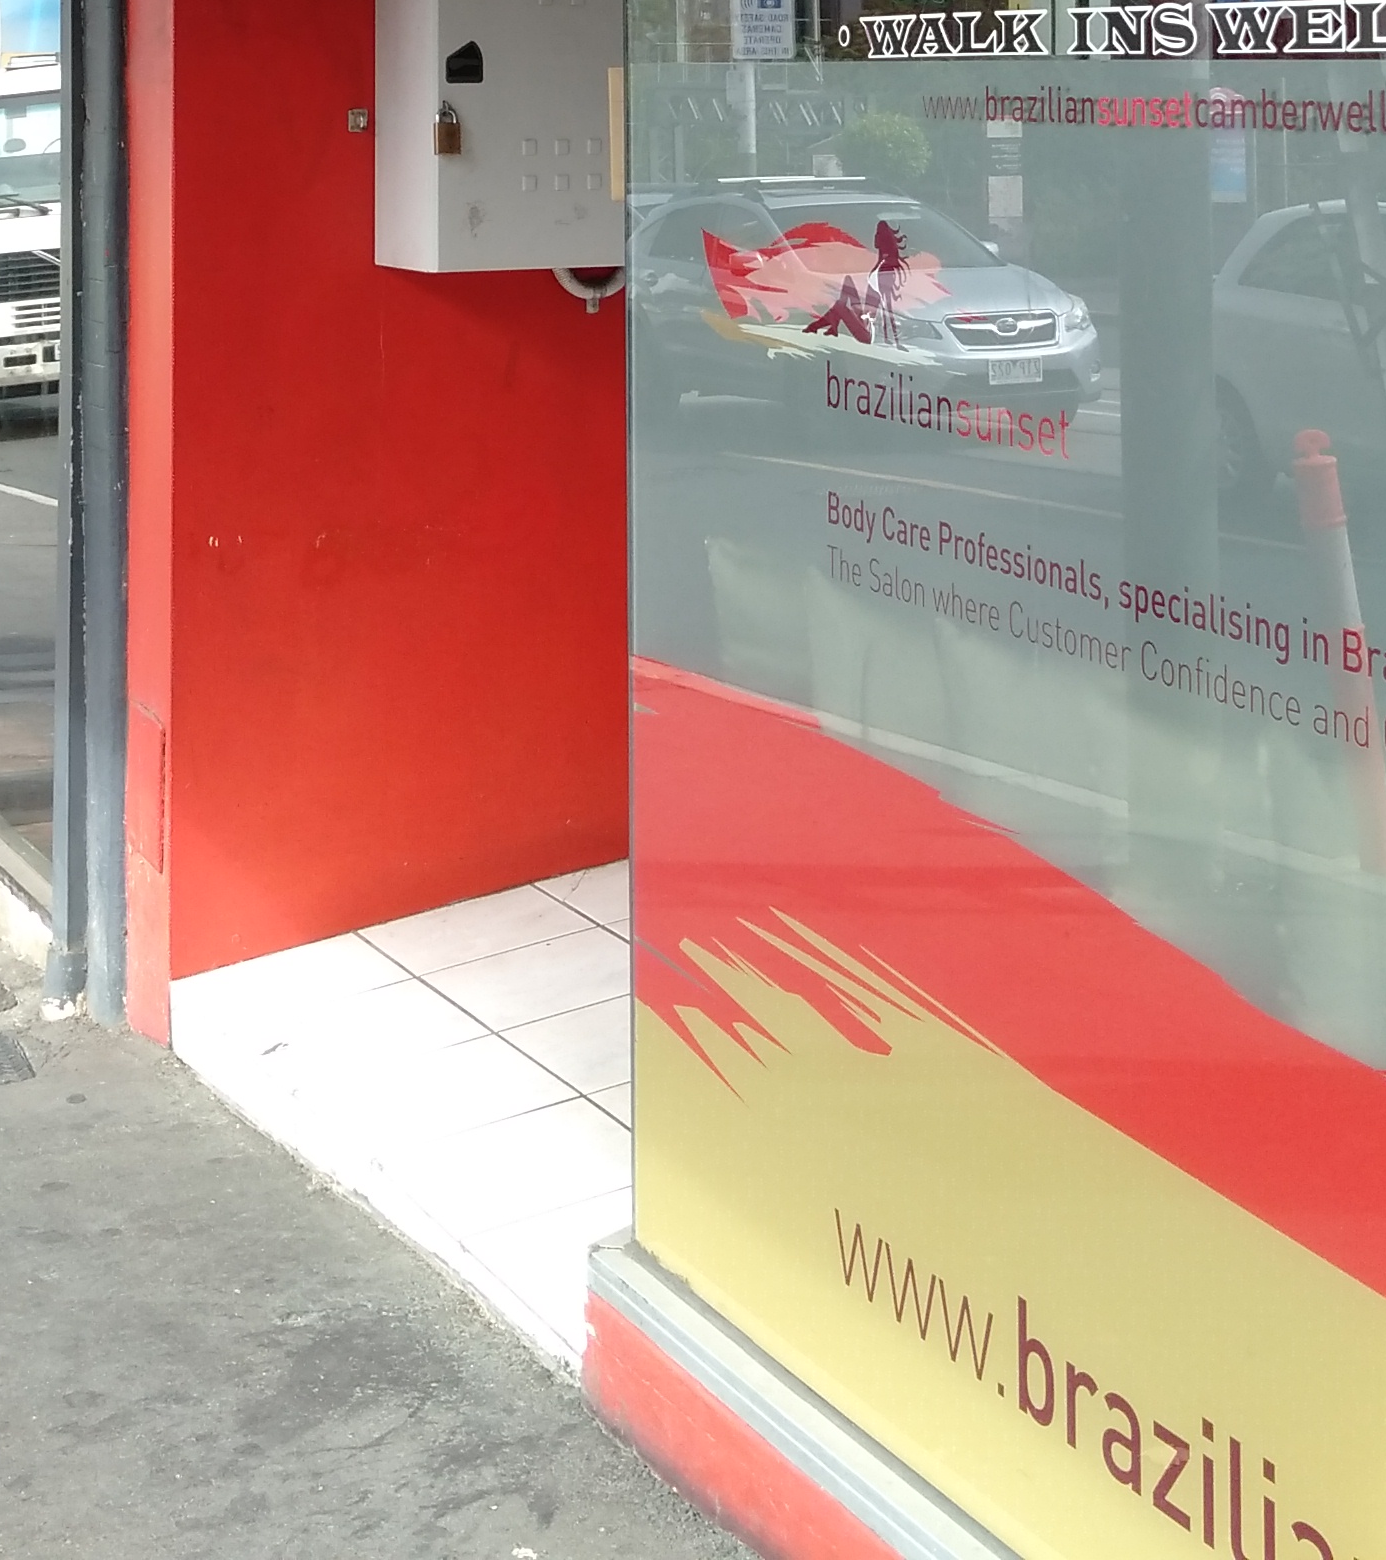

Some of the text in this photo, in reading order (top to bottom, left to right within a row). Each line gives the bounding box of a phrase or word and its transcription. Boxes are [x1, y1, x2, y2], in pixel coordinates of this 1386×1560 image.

[860, 7, 1049, 59] WALK
[1066, 2, 1199, 56] INS
[825, 361, 1071, 460] braziliansunset
[826, 491, 877, 543] Body
[881, 507, 932, 552] Care
[938, 521, 1110, 609] Professionals,
[1118, 579, 1291, 666] specialising
[1301, 616, 1330, 665] in
[826, 545, 862, 587] The
[869, 558, 926, 608] Salon
[932, 584, 1001, 632] where
[1009, 601, 1133, 672] Customer
[1140, 641, 1302, 728] Confidence
[1313, 701, 1369, 749] and
